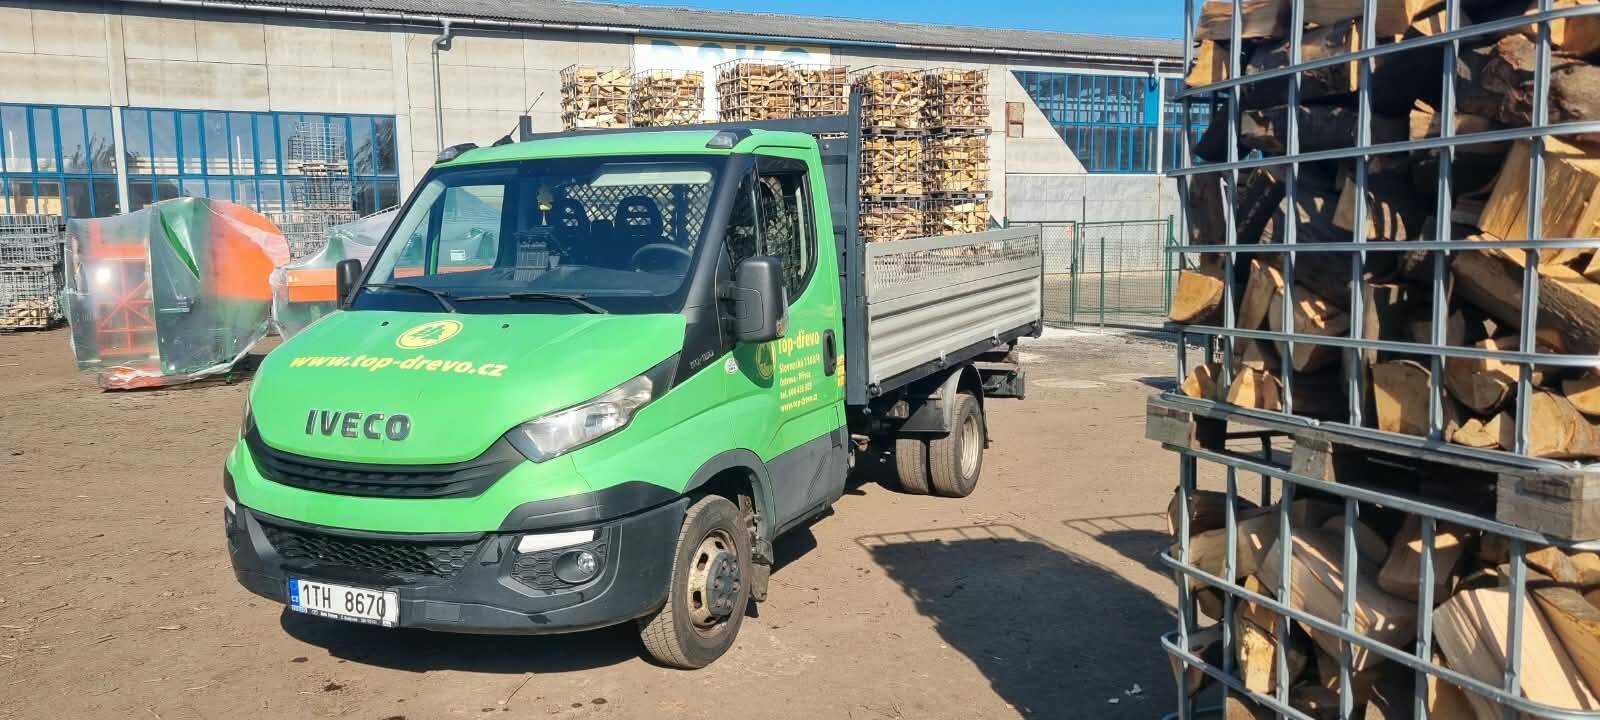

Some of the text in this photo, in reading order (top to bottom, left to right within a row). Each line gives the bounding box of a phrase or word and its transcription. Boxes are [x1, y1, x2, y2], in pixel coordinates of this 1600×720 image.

[289, 354, 508, 377] www.top-drevo.cz
[305, 409, 411, 441] IVECO
[303, 584, 386, 618] 1TH 8670
